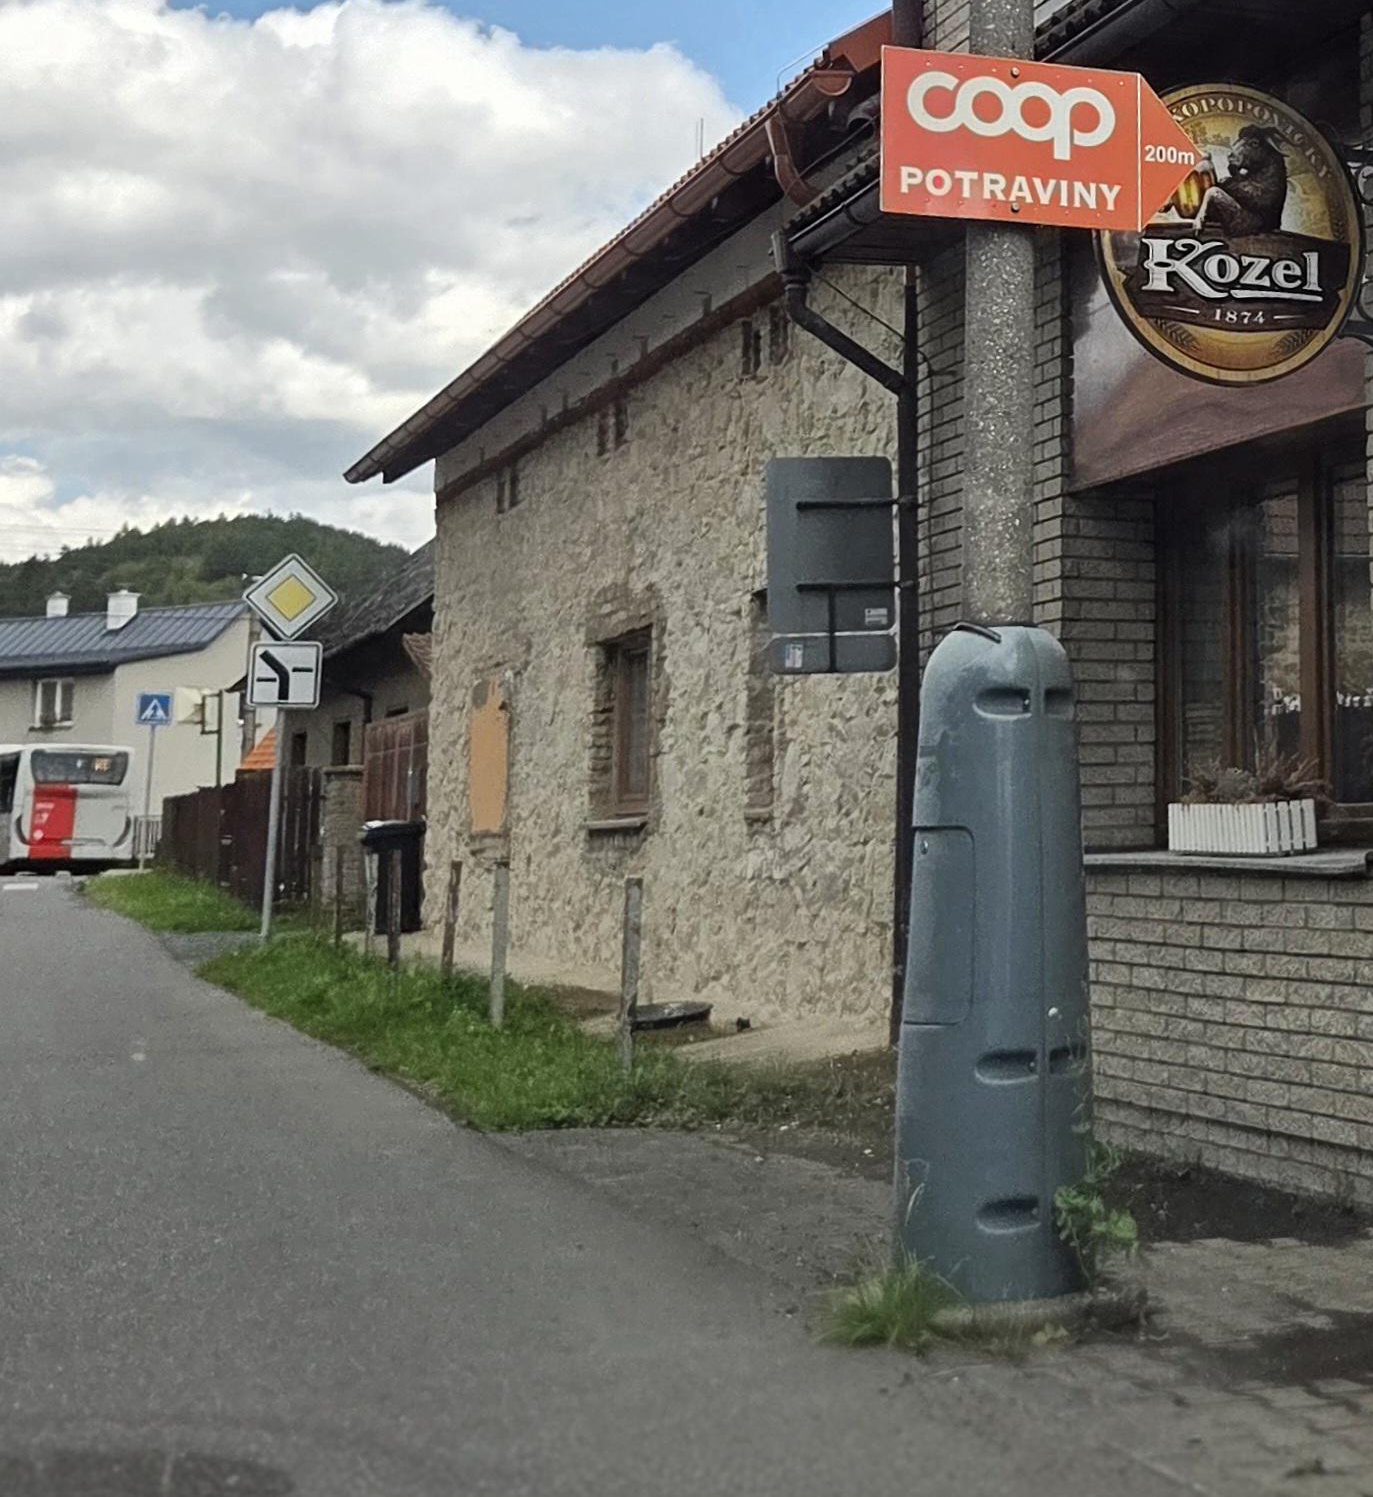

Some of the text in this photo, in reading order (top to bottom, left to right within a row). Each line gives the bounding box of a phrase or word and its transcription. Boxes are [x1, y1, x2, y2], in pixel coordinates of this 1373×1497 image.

[1144, 145, 1195, 165] 200m
[900, 165, 1121, 211] POTRAVINY
[1142, 238, 1323, 298] Kozel
[1213, 308, 1265, 323] 1874
